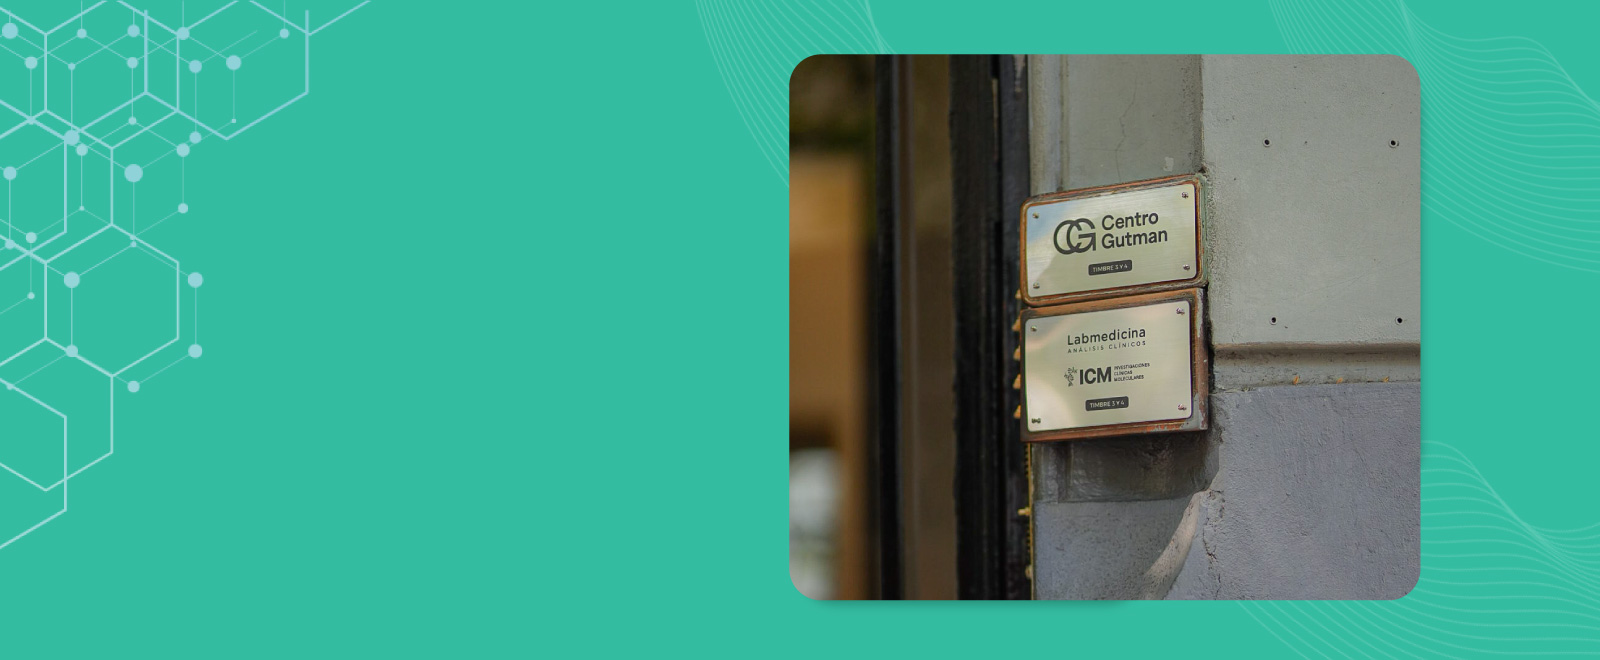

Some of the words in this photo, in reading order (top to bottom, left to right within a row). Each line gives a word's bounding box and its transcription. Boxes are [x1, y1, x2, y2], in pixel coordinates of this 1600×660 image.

[1102, 212, 1158, 230] Centro
[1102, 230, 1168, 249] Gutman
[1068, 328, 1146, 346] Labmedicina
[1080, 366, 1112, 385] ICM
